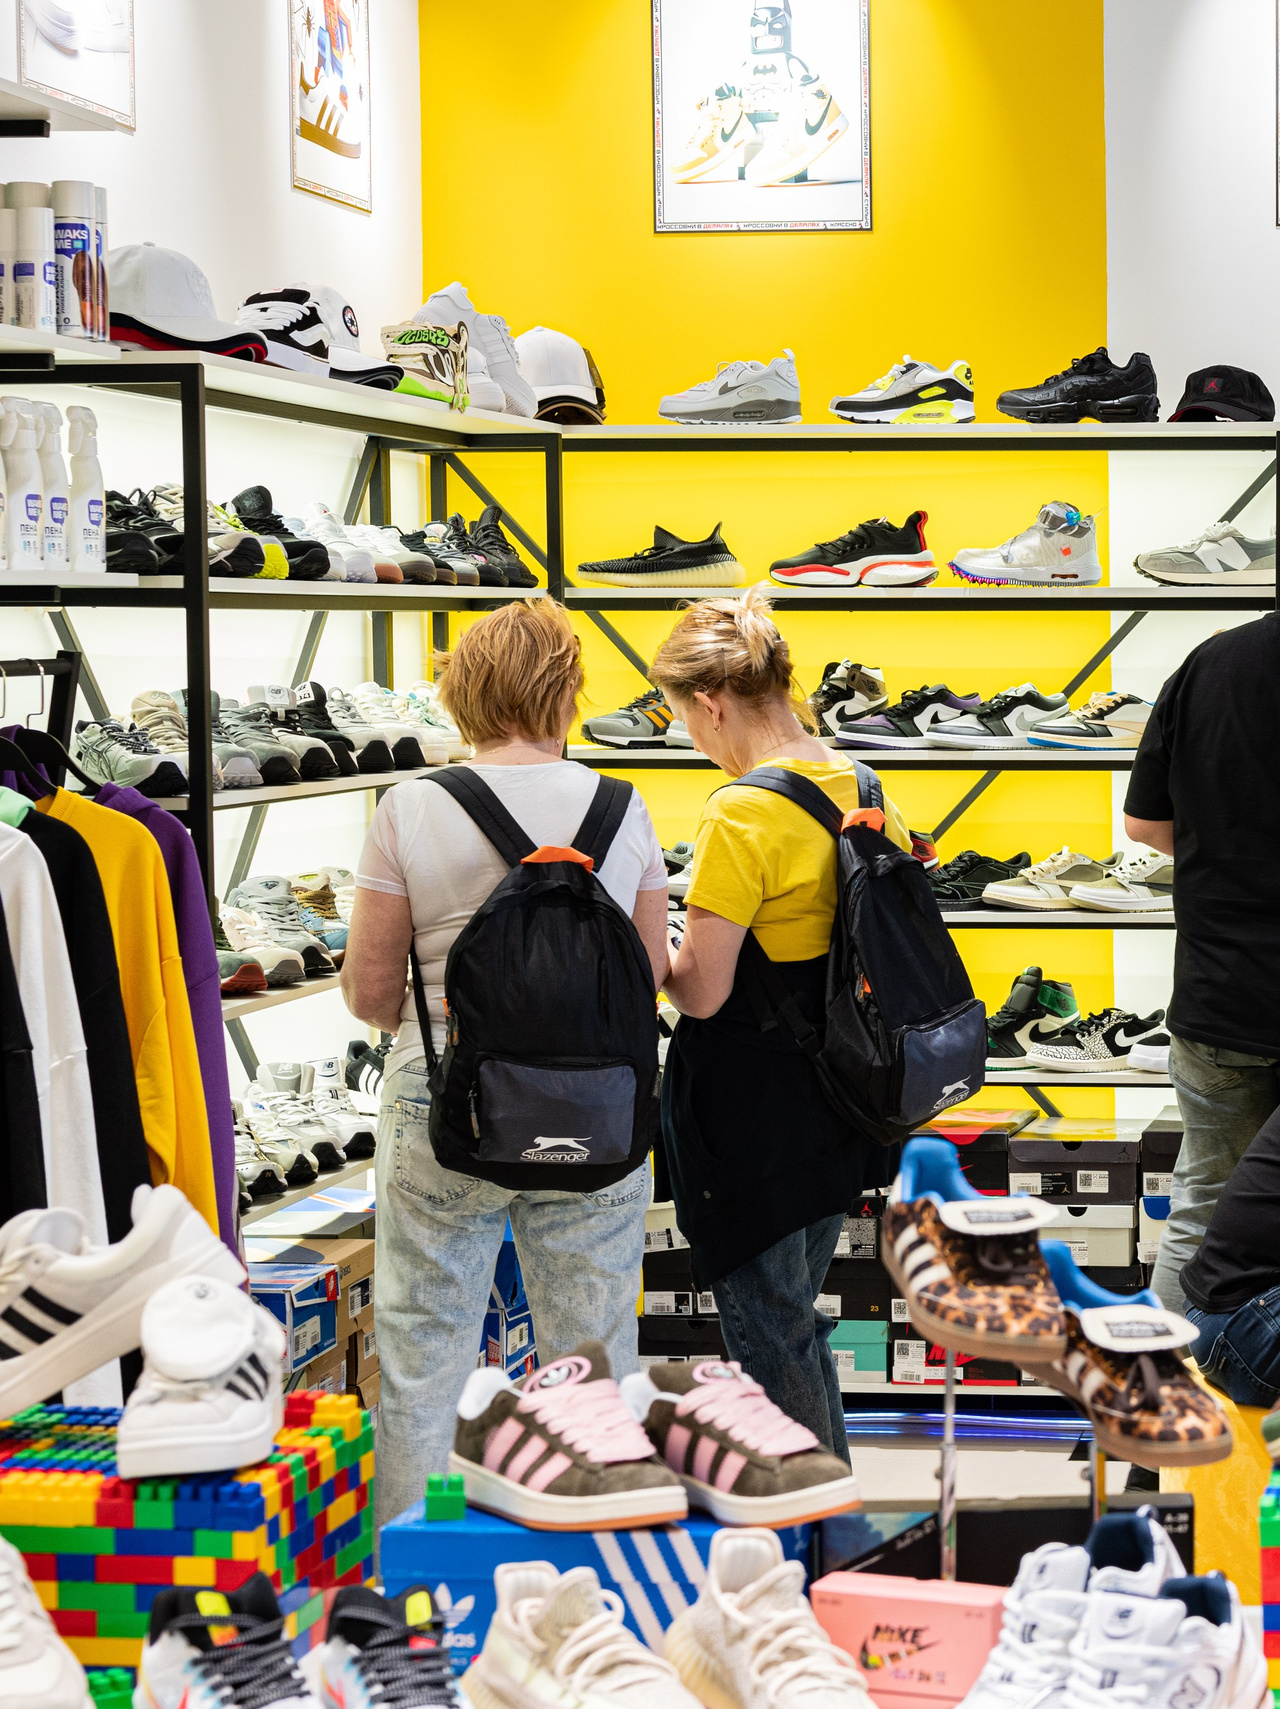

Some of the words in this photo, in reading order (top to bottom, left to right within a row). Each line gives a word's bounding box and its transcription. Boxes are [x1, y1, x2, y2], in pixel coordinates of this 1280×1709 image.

[55, 229, 88, 240] WAKS
[20, 524, 37, 532] ПЕНА
[520, 1151, 590, 1163] Slazenger
